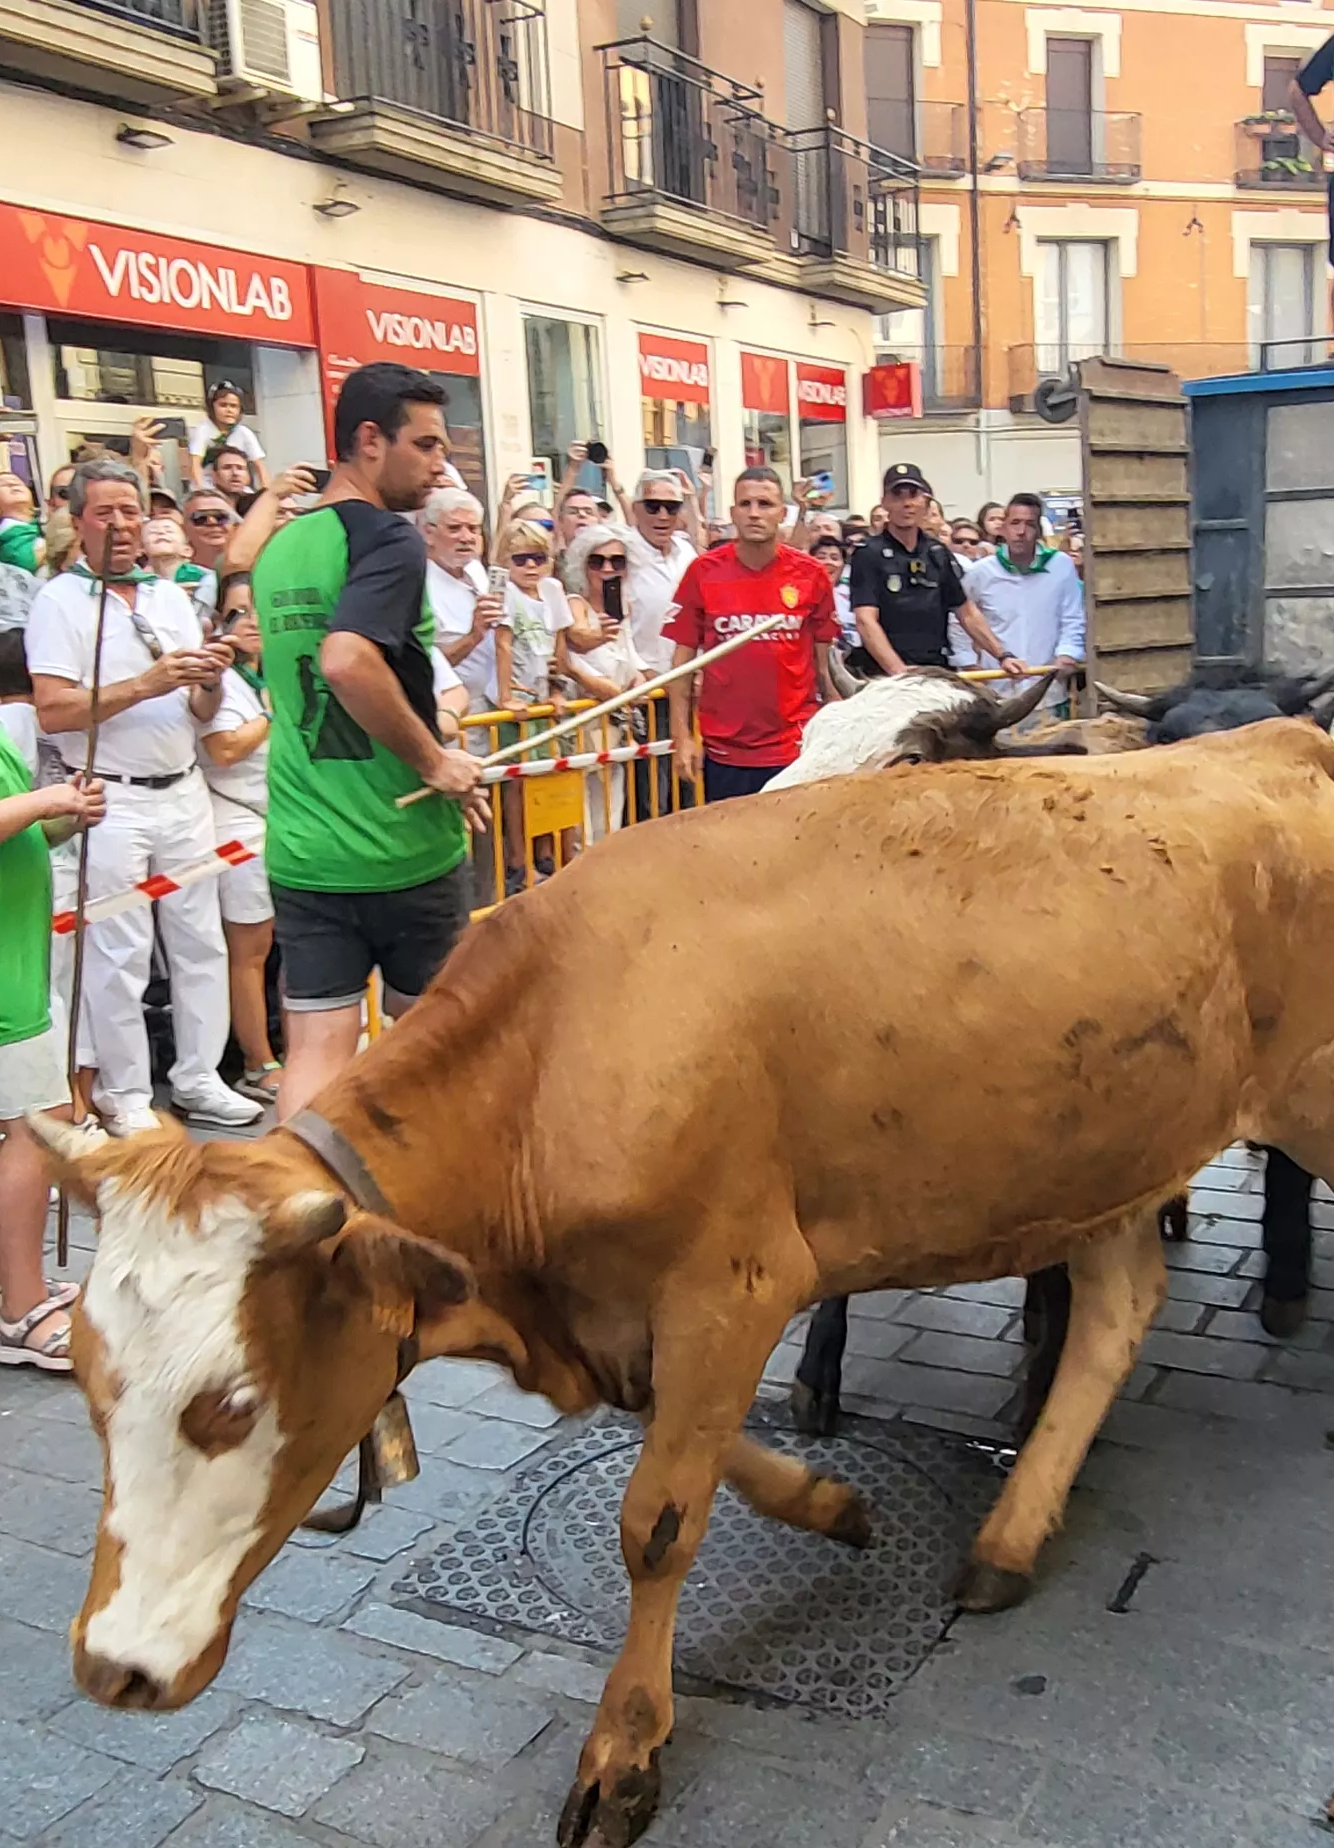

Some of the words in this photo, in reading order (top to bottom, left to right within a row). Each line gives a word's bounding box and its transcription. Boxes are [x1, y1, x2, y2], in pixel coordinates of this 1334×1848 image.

[88, 244, 292, 320] VISIONLAB
[365, 308, 477, 356] VISIONLAB
[714, 613, 804, 633] CARAAN
